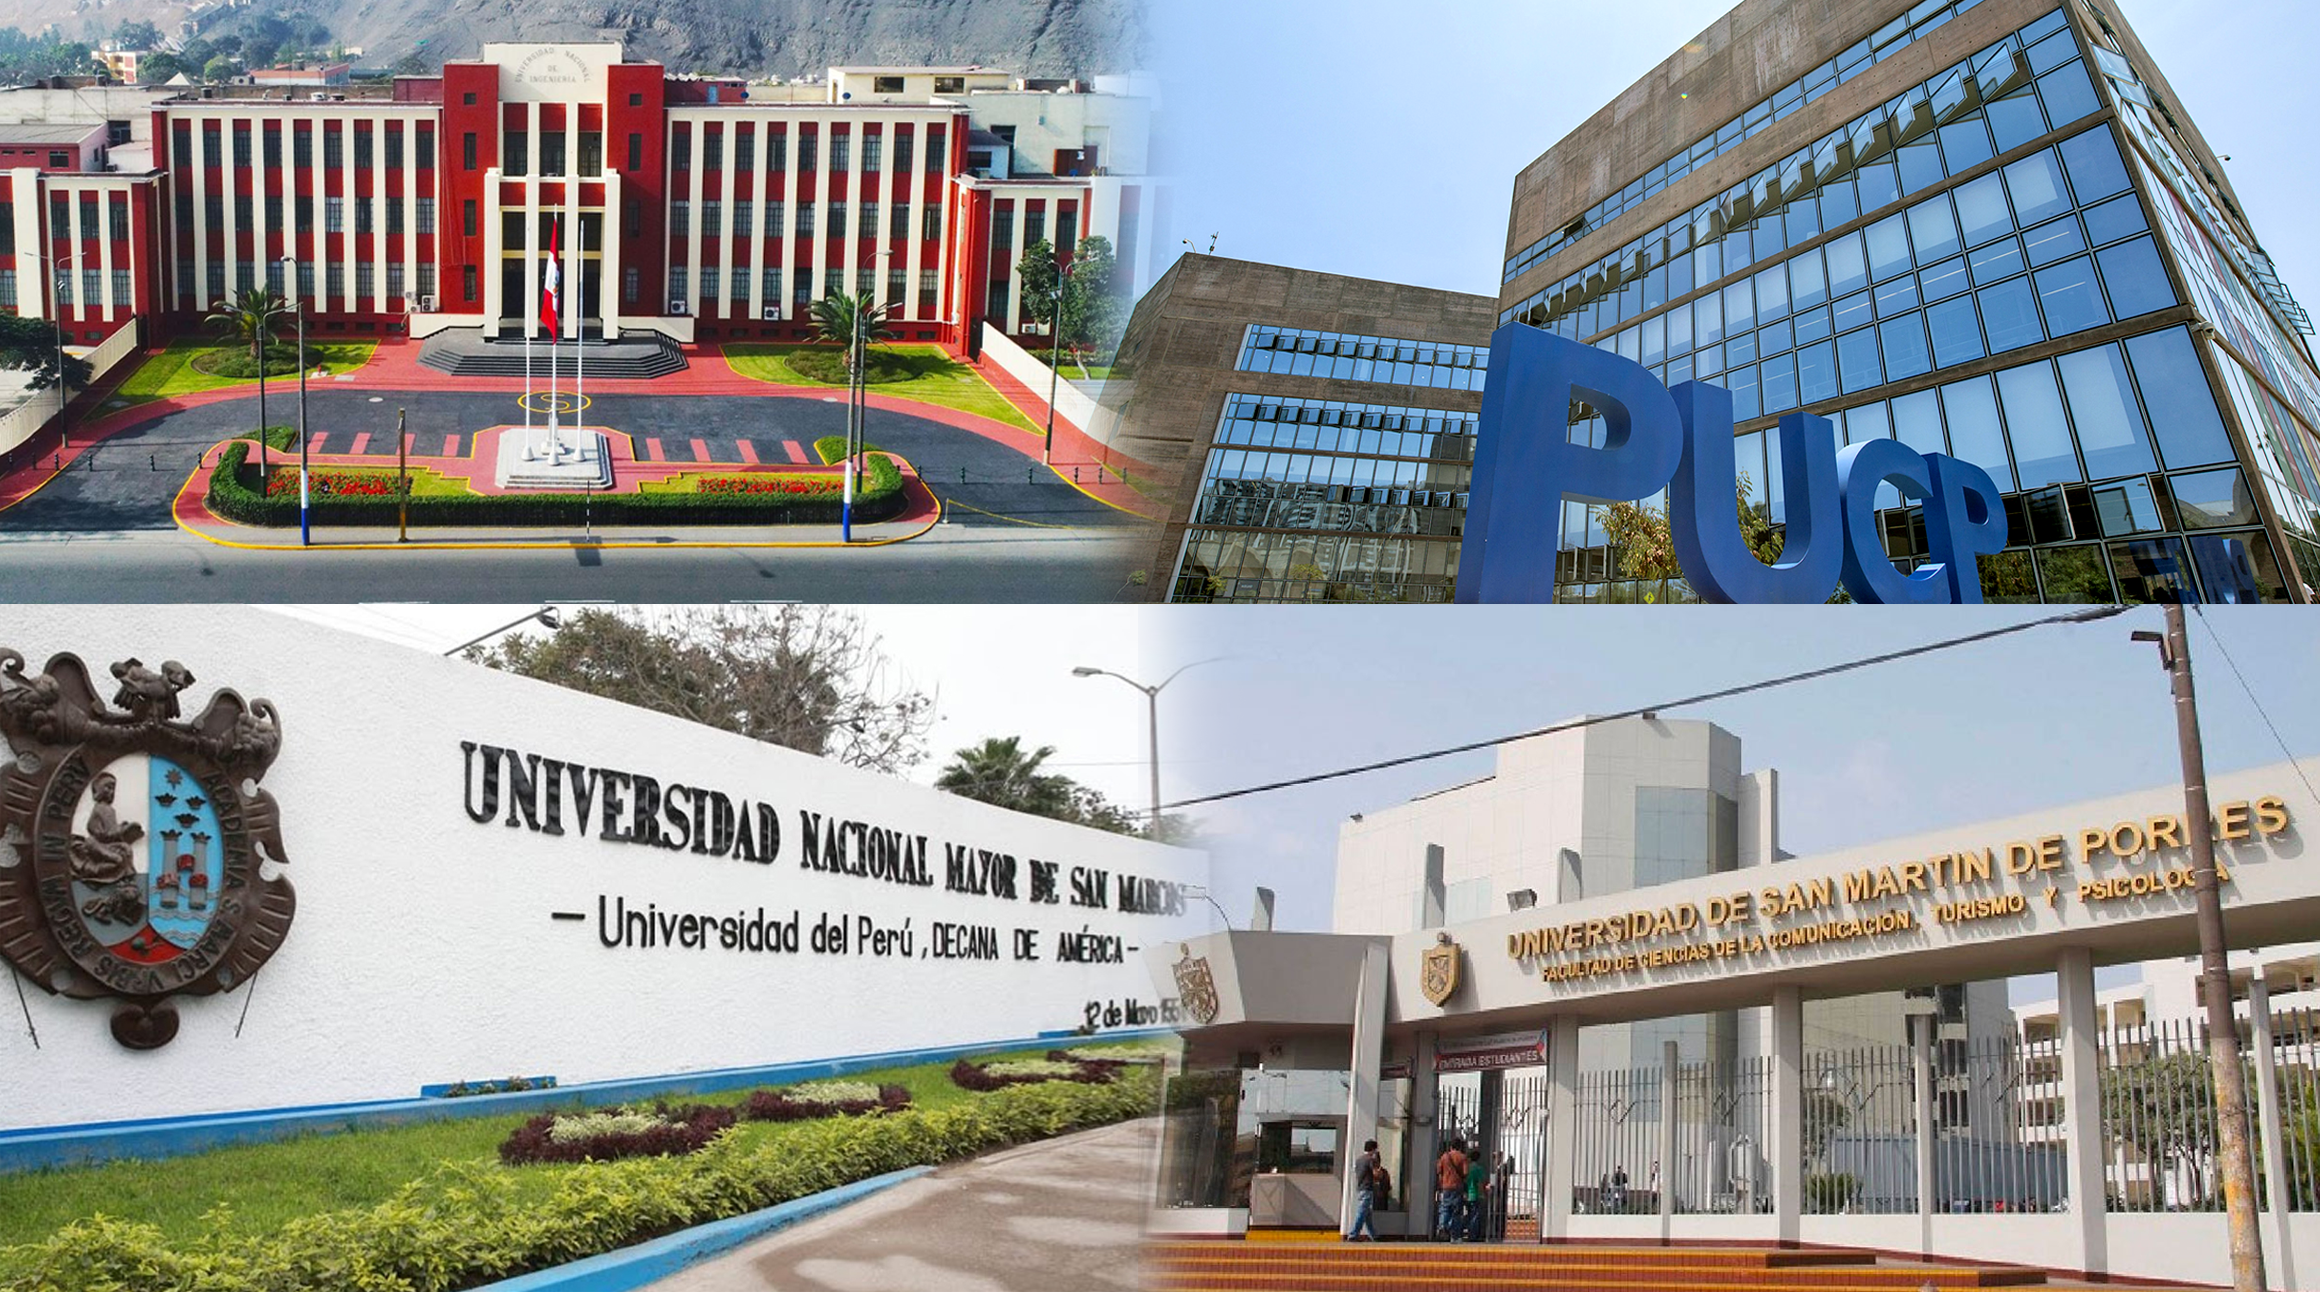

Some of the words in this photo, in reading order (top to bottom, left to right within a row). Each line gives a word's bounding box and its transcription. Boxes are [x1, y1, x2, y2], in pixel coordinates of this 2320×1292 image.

[515, 47, 554, 83] UNIVERSIDAD
[565, 50, 591, 83] NACIONAL
[1455, 321, 2007, 604] PUCP
[460, 741, 780, 865] UNIVERSIDAD
[800, 810, 933, 887] NACIONAL
[945, 842, 1018, 901] MAYOR
[1029, 859, 1060, 905] DE
[1070, 866, 1108, 910] SAN
[1118, 874, 1186, 917] MARCOS
[1507, 902, 1699, 960] UNIVERSIDAD
[1707, 890, 1750, 927] DE
[1760, 876, 1834, 918] SAN
[1843, 847, 1991, 904] MARTIN
[2006, 834, 2064, 878] DE
[2080, 794, 2288, 864] PORES
[599, 894, 799, 953] Universidad
[811, 912, 848, 954] del
[932, 921, 999, 960] DECANA
[1014, 928, 1039, 961] DE
[1542, 959, 1613, 982] FACULTAD
[1615, 956, 1636, 972] DE
[1638, 942, 1709, 969] CIENCIAS
[1714, 940, 1737, 958] DE
[1741, 933, 1763, 953] LA
[1932, 893, 2025, 925] TURISMO
[2043, 887, 2060, 908] Y
[1103, 999, 1122, 1028] de
